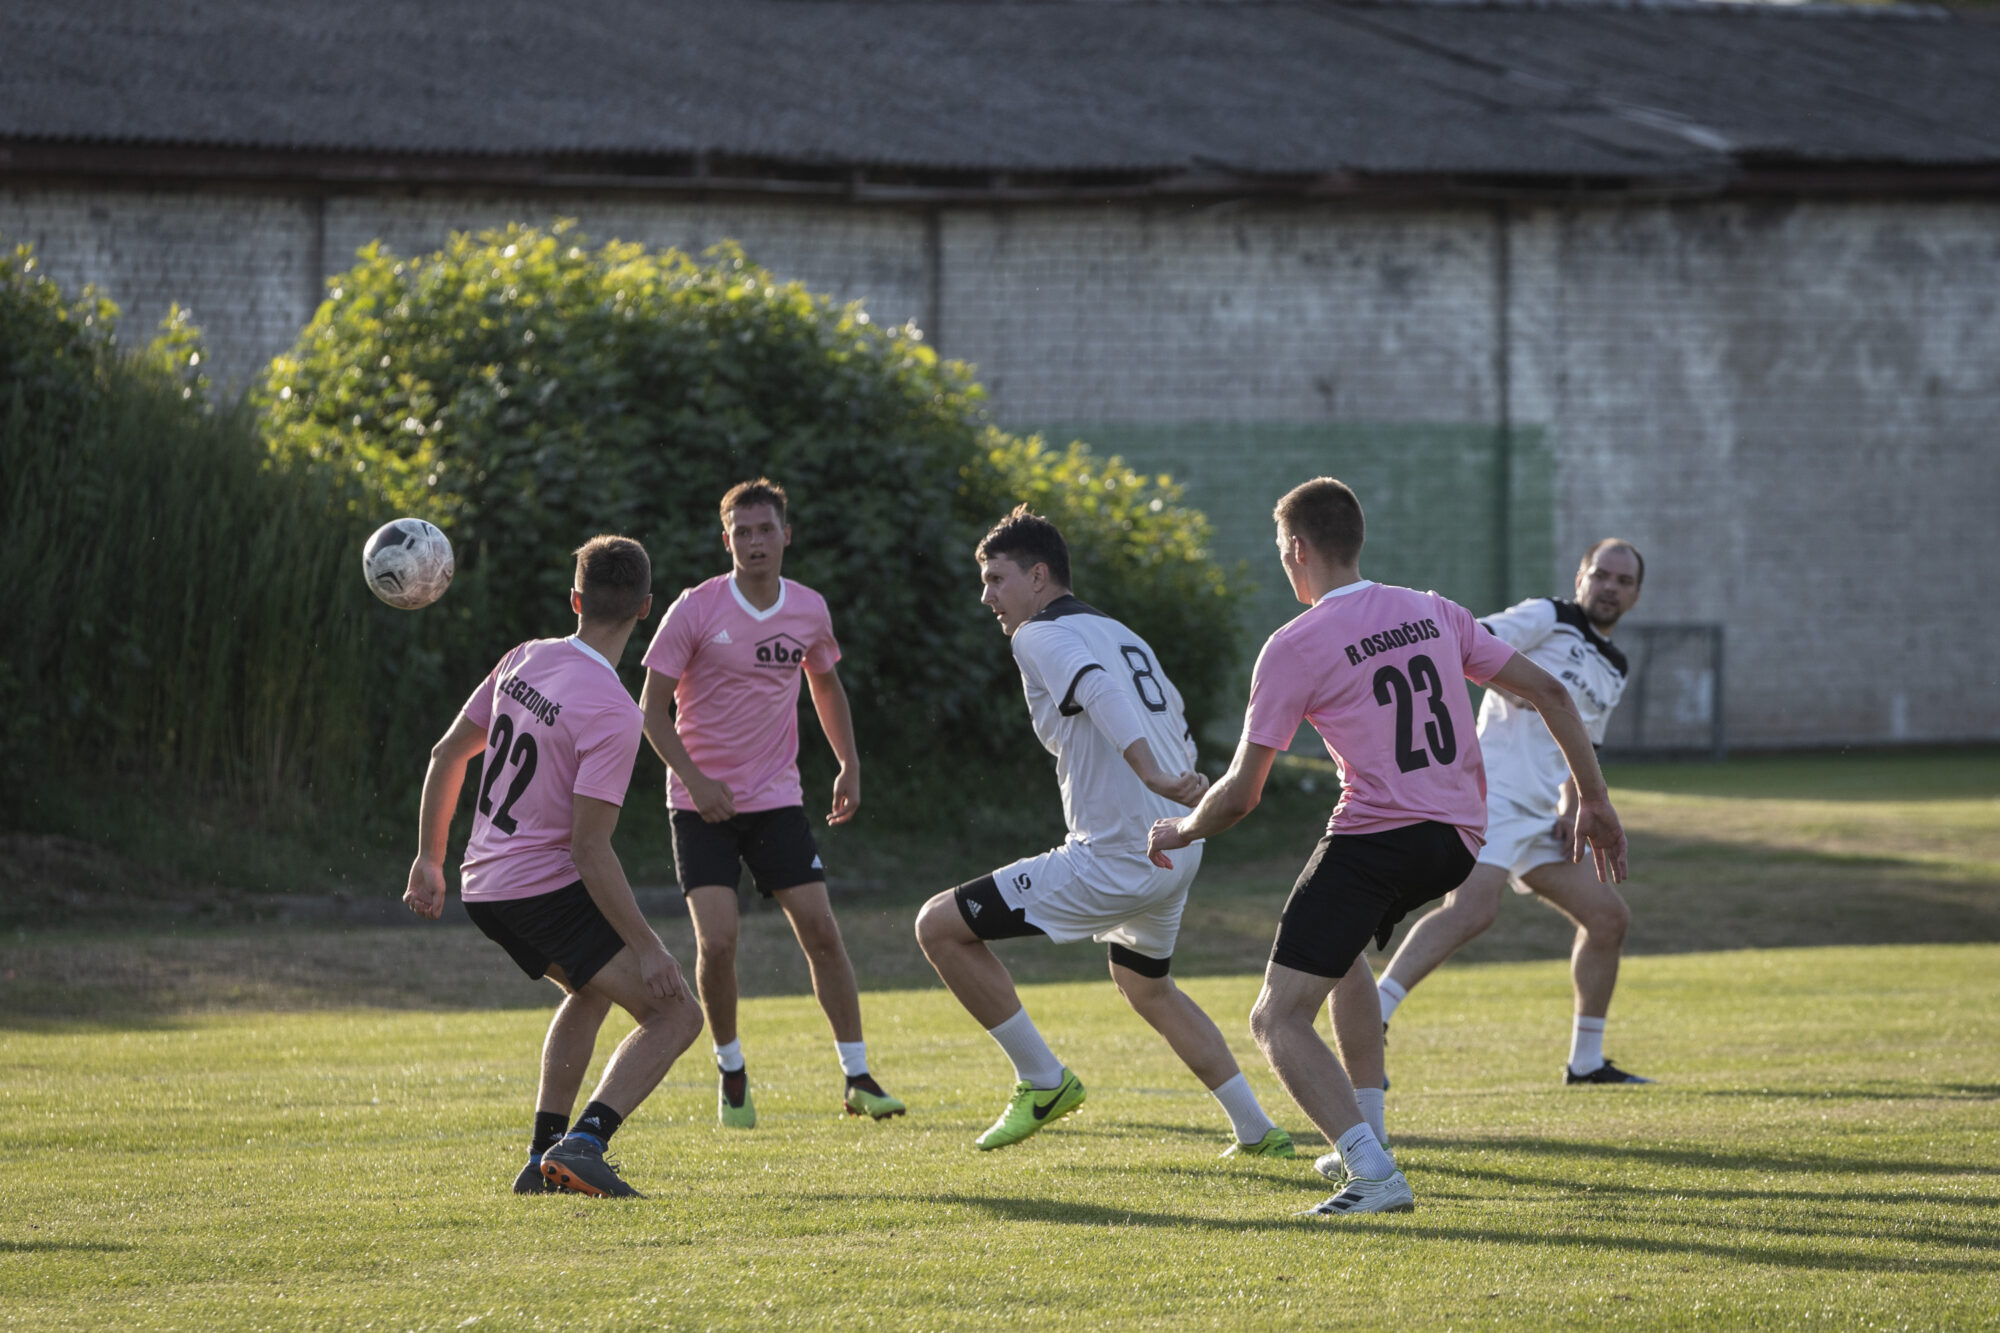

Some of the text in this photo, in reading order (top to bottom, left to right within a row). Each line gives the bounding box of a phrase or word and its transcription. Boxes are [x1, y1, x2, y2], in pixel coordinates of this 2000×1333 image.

[1120, 643, 1167, 713] 8
[1344, 618, 1441, 666] R.OSADČIJS
[1373, 654, 1457, 774] 23
[479, 713, 538, 836] 22
